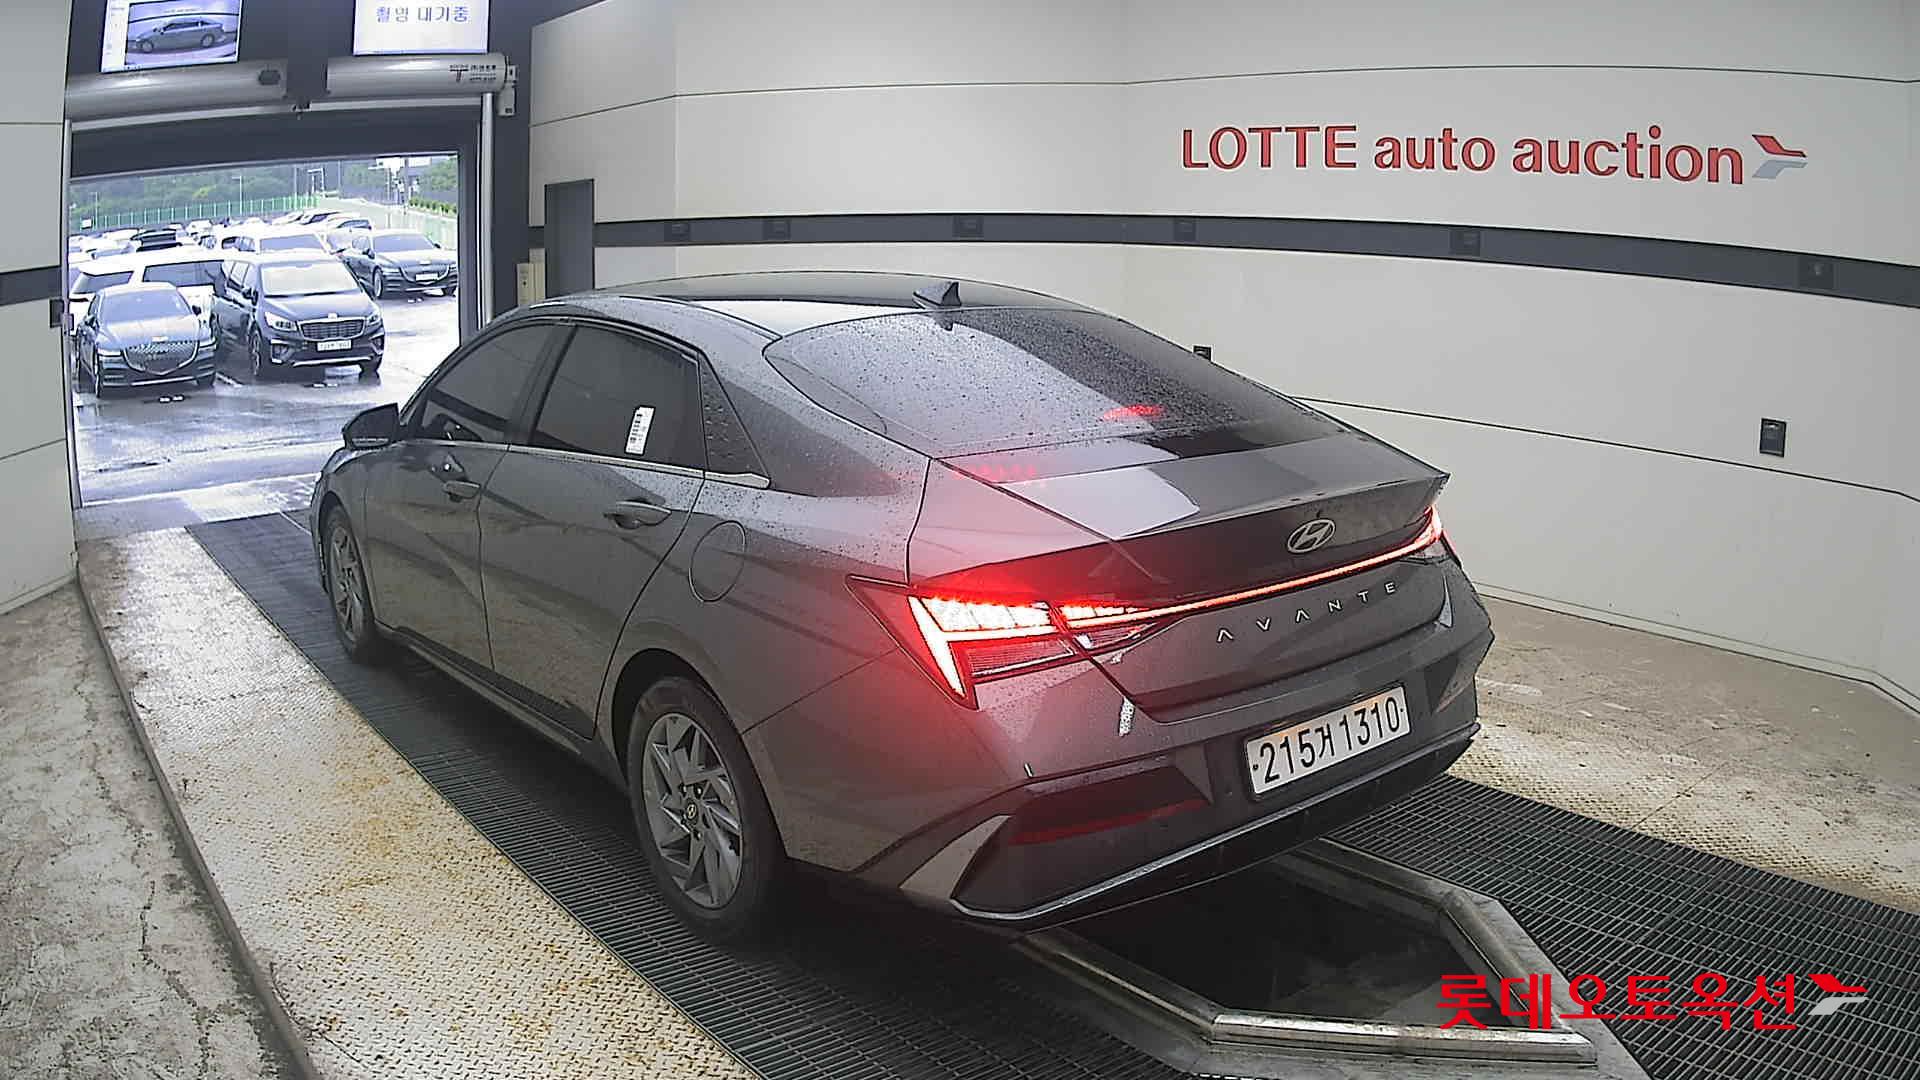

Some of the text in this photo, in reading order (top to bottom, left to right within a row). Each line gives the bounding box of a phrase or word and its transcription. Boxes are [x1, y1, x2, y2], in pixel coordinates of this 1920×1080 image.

[417, 6, 469, 23] 대기중
[1182, 125, 1744, 186] LOTTE auto auction
[1216, 582, 1398, 643] AVANTE
[1339, 696, 1401, 751] 1310
